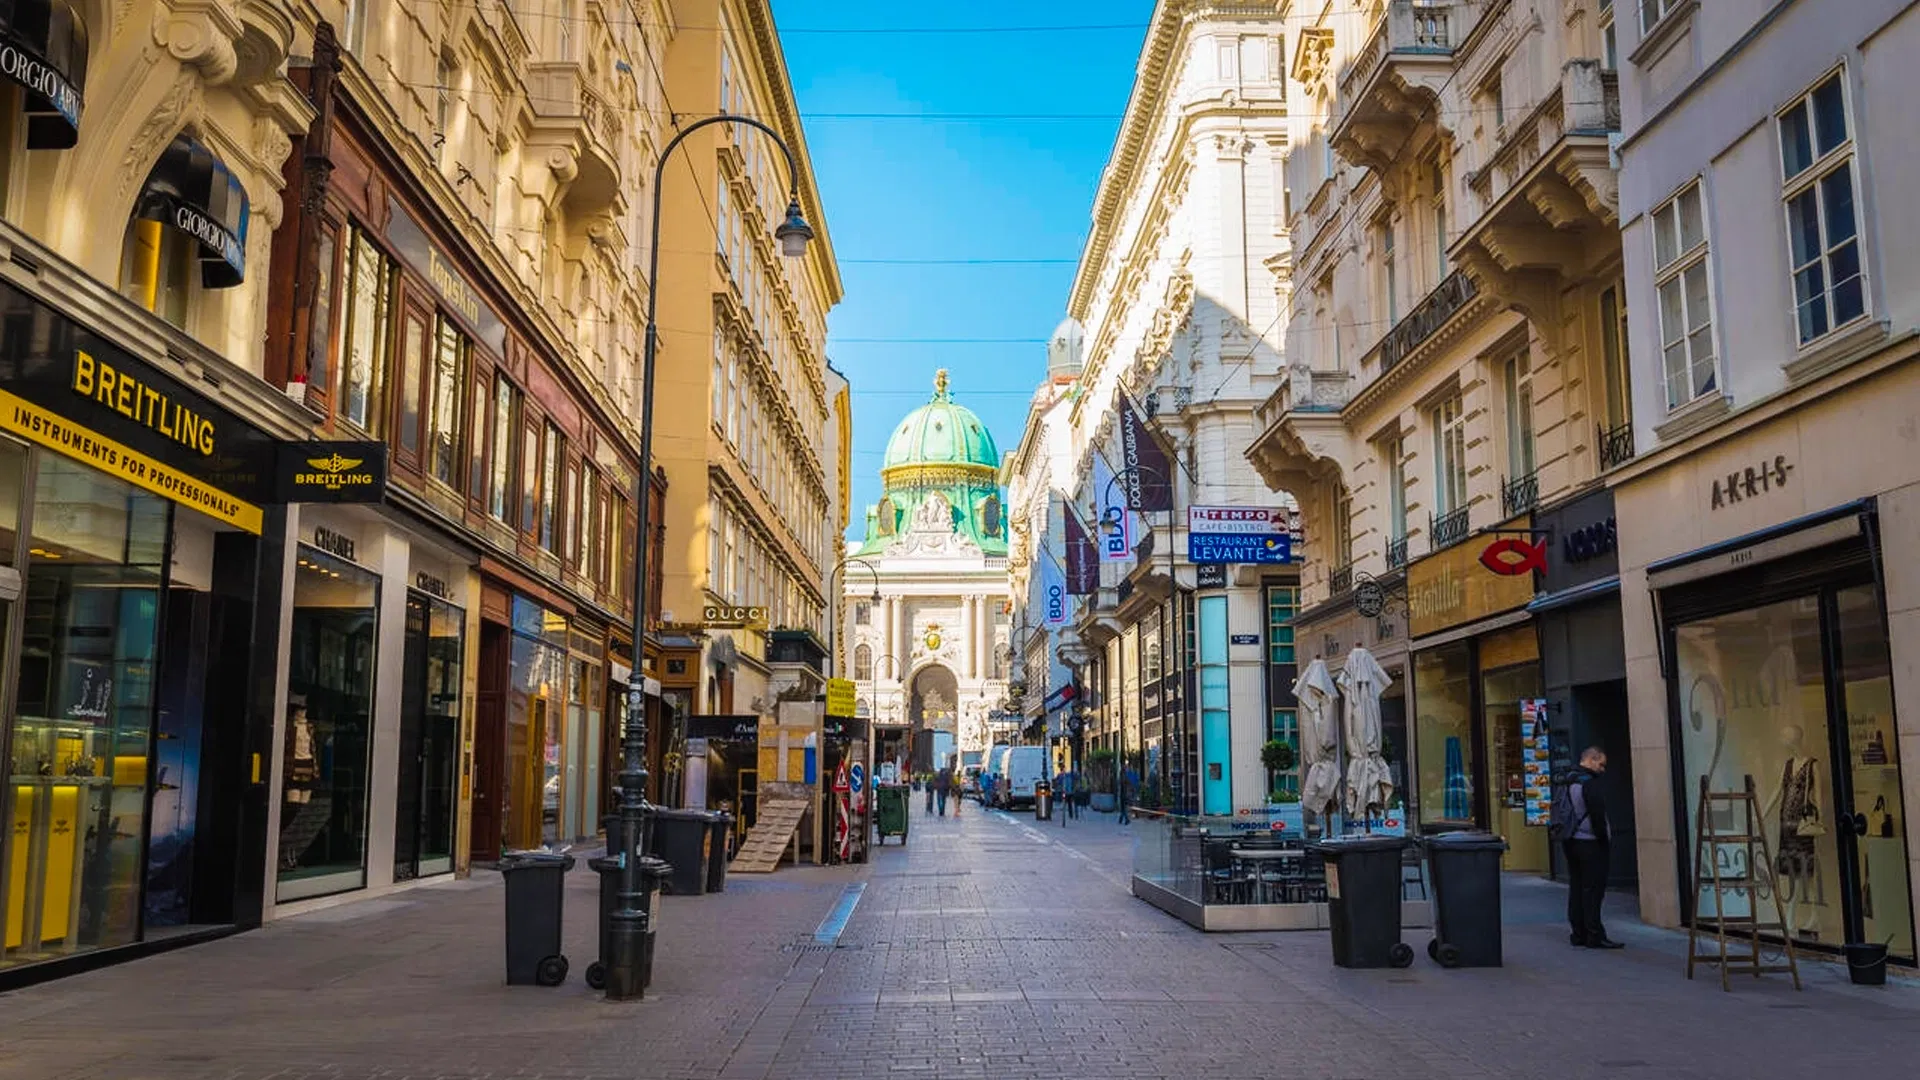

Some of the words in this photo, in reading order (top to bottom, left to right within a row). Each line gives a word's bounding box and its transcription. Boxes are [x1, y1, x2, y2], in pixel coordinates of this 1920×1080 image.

[0, 44, 57, 98] ORGIO
[177, 207, 224, 251] GIORGIO
[75, 350, 216, 456] BREITLING
[13, 407, 118, 465] INSTRUMENTS
[121, 455, 146, 477] FOR
[1124, 409, 1139, 466] GABBANA
[295, 474, 373, 485] BREITLING
[1108, 506, 1125, 552] BDO
[1208, 510, 1268, 520] TEMPO
[314, 525, 357, 562] CHANEL
[1193, 537, 1264, 546] RESTAURANT
[1193, 547, 1265, 560] LEVANTE
[705, 608, 768, 620] GUCCI
[1049, 585, 1061, 618] BDO
[1231, 822, 1270, 830] NORDSEE
[1344, 819, 1384, 828] NORSEE
